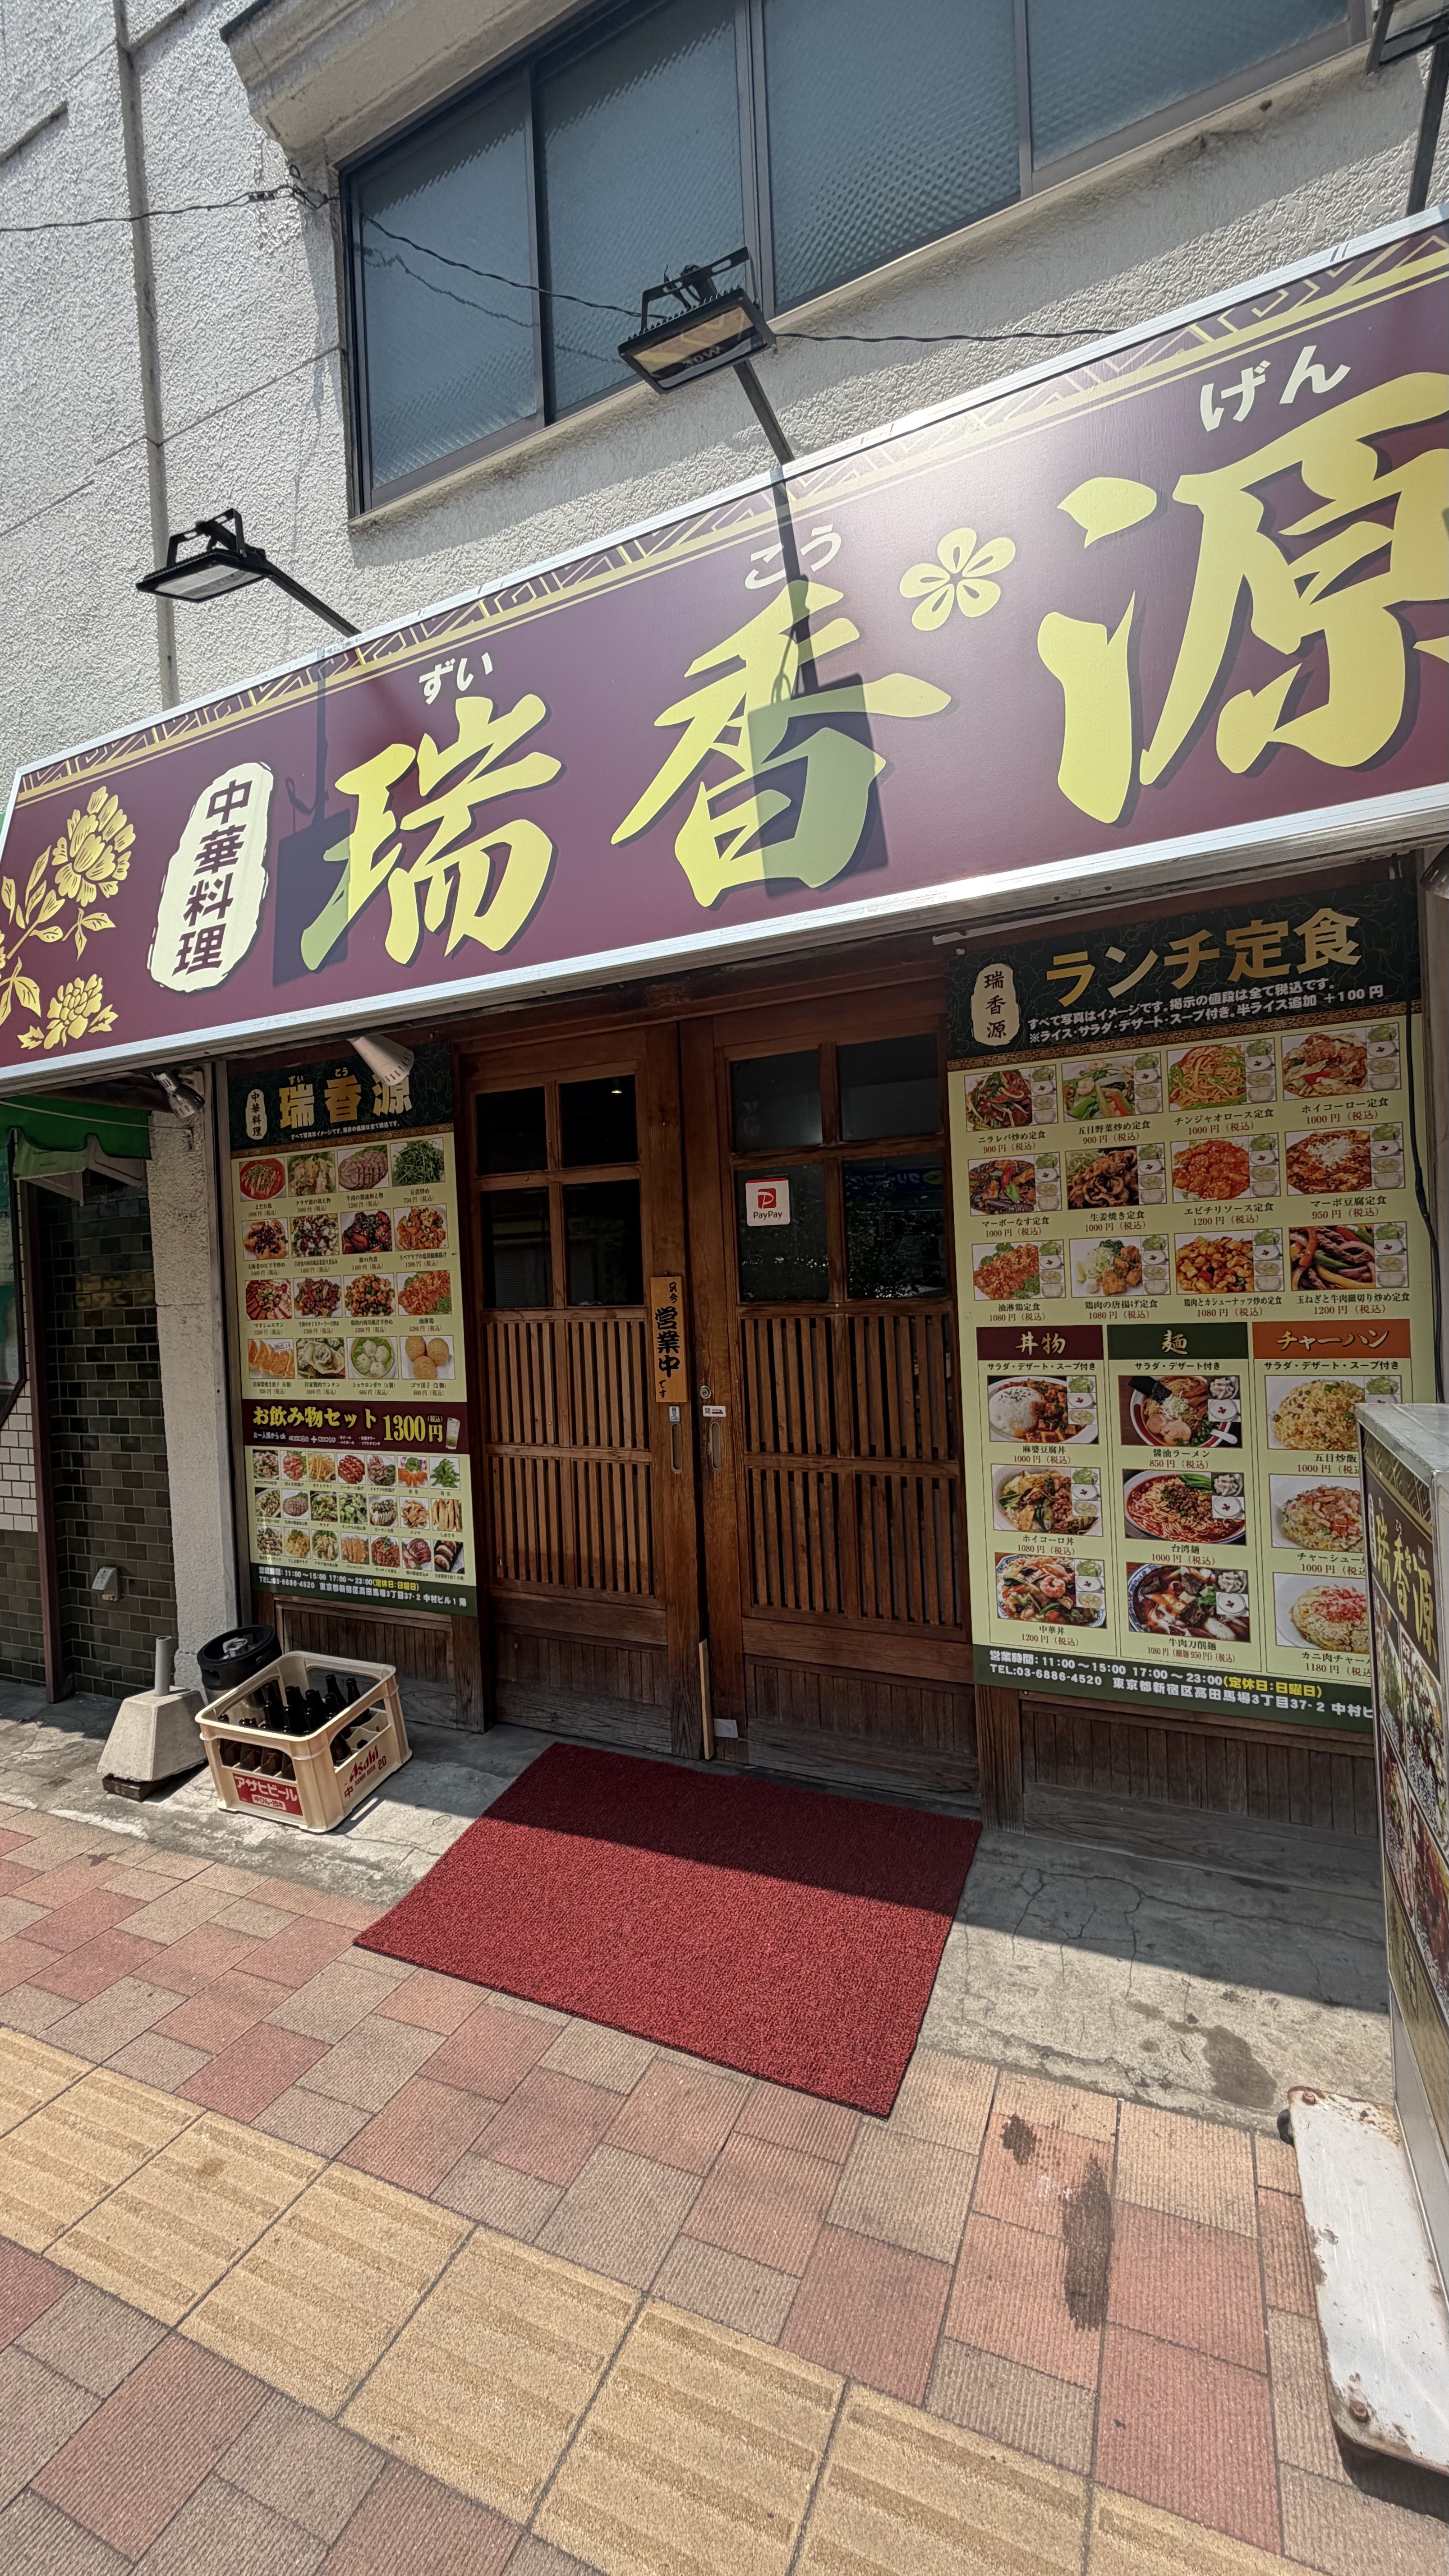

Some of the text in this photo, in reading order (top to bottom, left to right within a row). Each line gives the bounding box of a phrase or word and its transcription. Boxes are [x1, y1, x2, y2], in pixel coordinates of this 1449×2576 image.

[419, 345, 1351, 704] ずい こう げん
[172, 780, 252, 976] 中華料理
[1046, 908, 1362, 1007] ランチ定食
[984, 971, 1007, 1039] 瑞香源
[1028, 978, 1334, 1030] すべて写真はイメージです。掲示の値段は全て税込です。
[289, 1067, 348, 1085] ずい こう
[279, 1075, 412, 1129] 瑞香源
[1302, 1098, 1389, 1113] ホイコーロー定食
[251, 1092, 262, 1136] 中華料理
[1174, 1109, 1274, 1126] チンジャオロース定食
[1078, 1120, 1150, 1135] 五目野菜炒め定食
[978, 1130, 1046, 1144] ニラレバ炒め定食
[1311, 1196, 1387, 1207] マーボ豆腐定食
[753, 1210, 783, 1220] PayPay
[1184, 1202, 1274, 1215] エビチリソース定食
[982, 1216, 1049, 1227] マーボーなす定食
[1090, 1210, 1145, 1222] 生姜焼き定食
[1085, 1299, 1158, 1310] 鶏肉の唐揚げ定食
[1184, 1295, 1282, 1307] 鶏肉とカシューナッツ炒め定食
[1297, 1292, 1410, 1305] 玉ねぎと牛肉細切り炒め定食
[998, 1303, 1040, 1312] 油淋鶏定食
[654, 1306, 681, 1378] 営業中
[1016, 1331, 1066, 1356] 丼物
[1161, 1330, 1188, 1355] 麺
[1276, 1330, 1389, 1352] チャーハン
[987, 1362, 1095, 1371] サラダ・デザート・スープ付き
[1135, 1362, 1220, 1371] サラダ・デザート付き
[1264, 1361, 1398, 1370] サラダ・デザート・スープ付き
[253, 1406, 376, 1429] お飲み物セット
[1022, 1445, 1066, 1454] 麻婆豆腐丼
[1153, 1449, 1210, 1458] 醤油ラーメン
[1314, 1454, 1358, 1463] 五目炒飯
[1023, 1535, 1074, 1545] ホイコーロ丼
[1039, 1625, 1065, 1635] 中華丼
[1169, 1638, 1217, 1651] 牛肉刀削麺
[350, 1744, 386, 1782] Asahi 20
[235, 1776, 298, 1802] アサヒビール
[345, 1785, 353, 1798] 中
